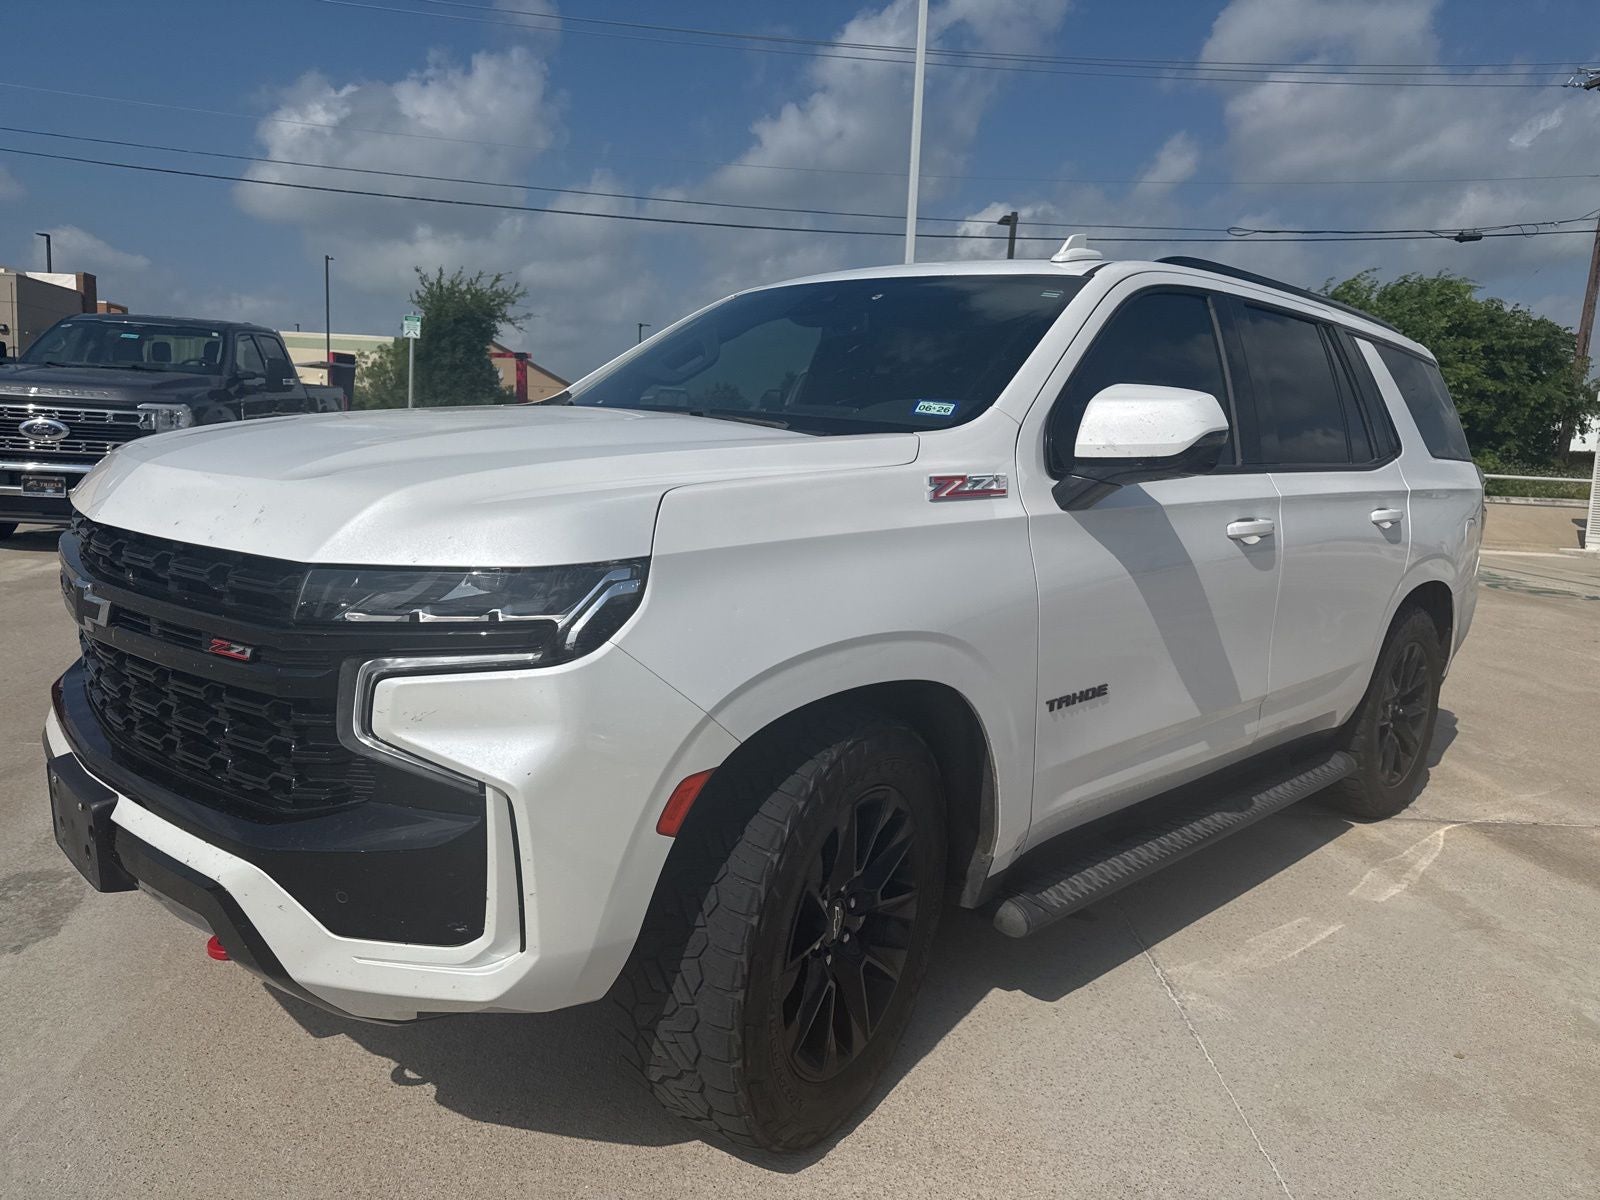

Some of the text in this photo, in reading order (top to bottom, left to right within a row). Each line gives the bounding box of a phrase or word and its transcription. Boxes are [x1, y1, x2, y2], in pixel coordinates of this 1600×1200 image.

[929, 474, 1008, 502] Z71
[208, 638, 252, 661] Z71
[1045, 683, 1109, 712] TAHOE
